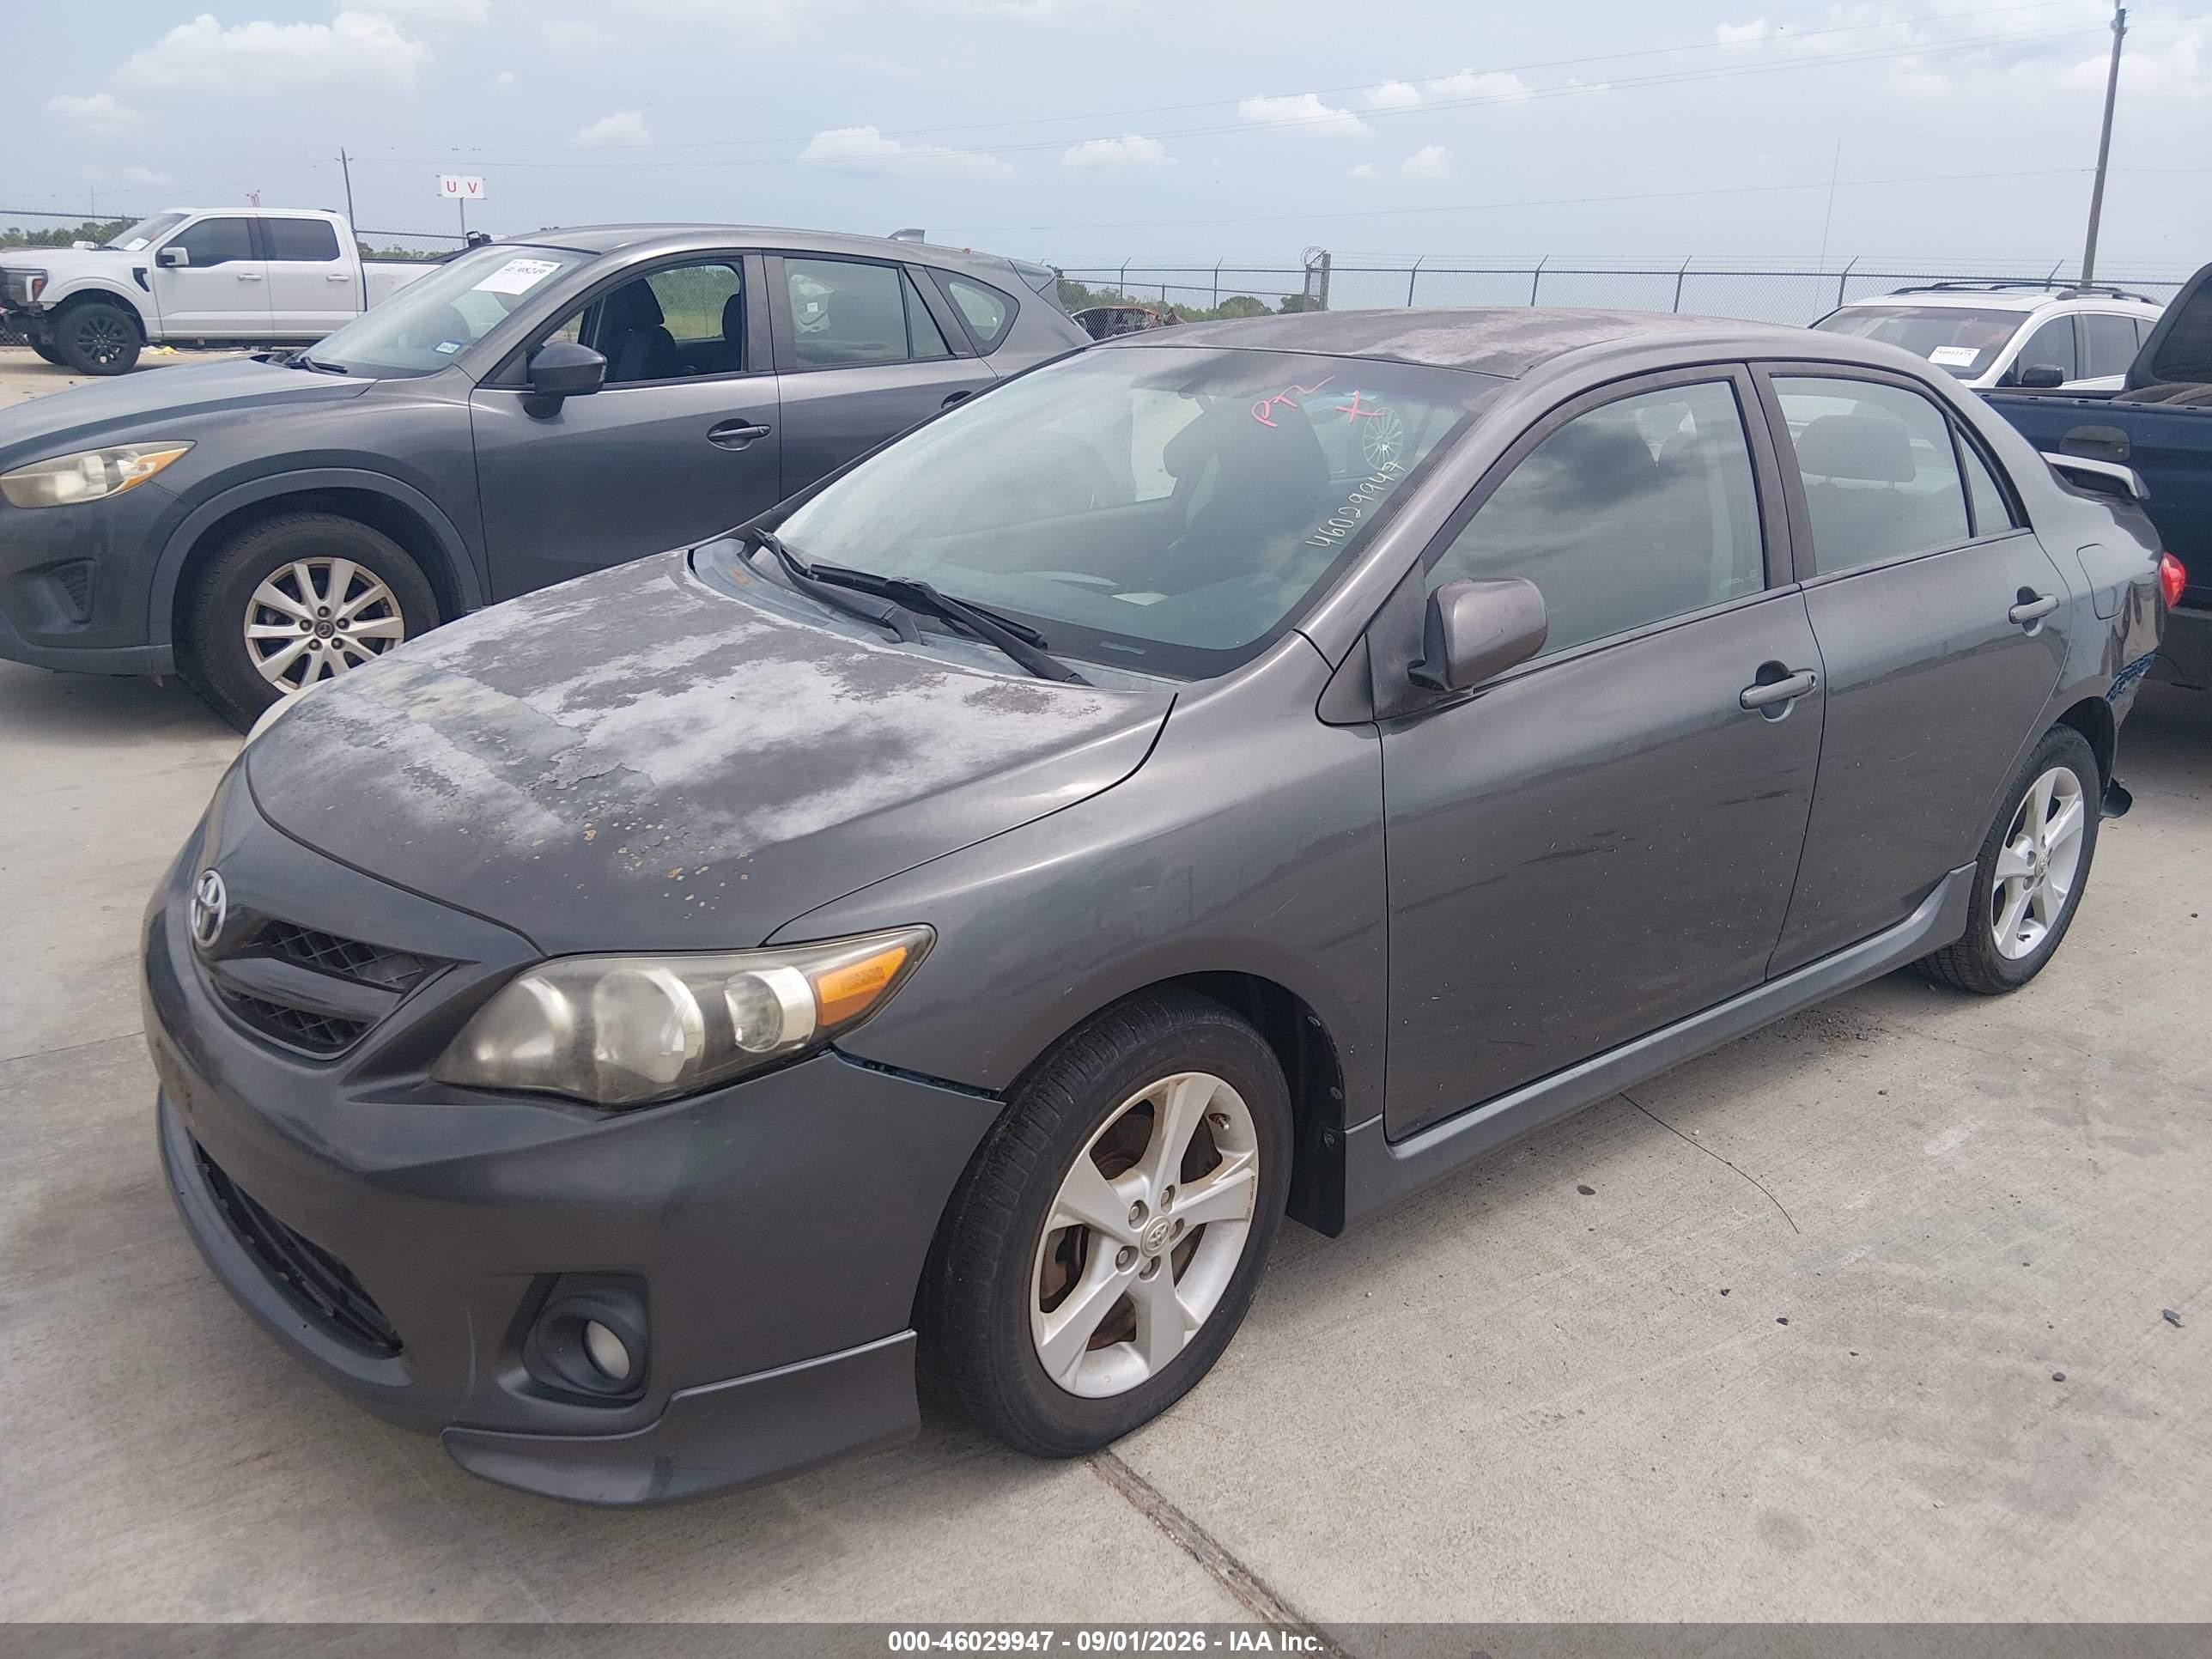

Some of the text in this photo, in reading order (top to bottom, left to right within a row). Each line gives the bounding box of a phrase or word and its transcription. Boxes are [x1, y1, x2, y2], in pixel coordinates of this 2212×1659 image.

[447, 180, 477, 194] U V
[1304, 461, 1407, 547] 46029947
